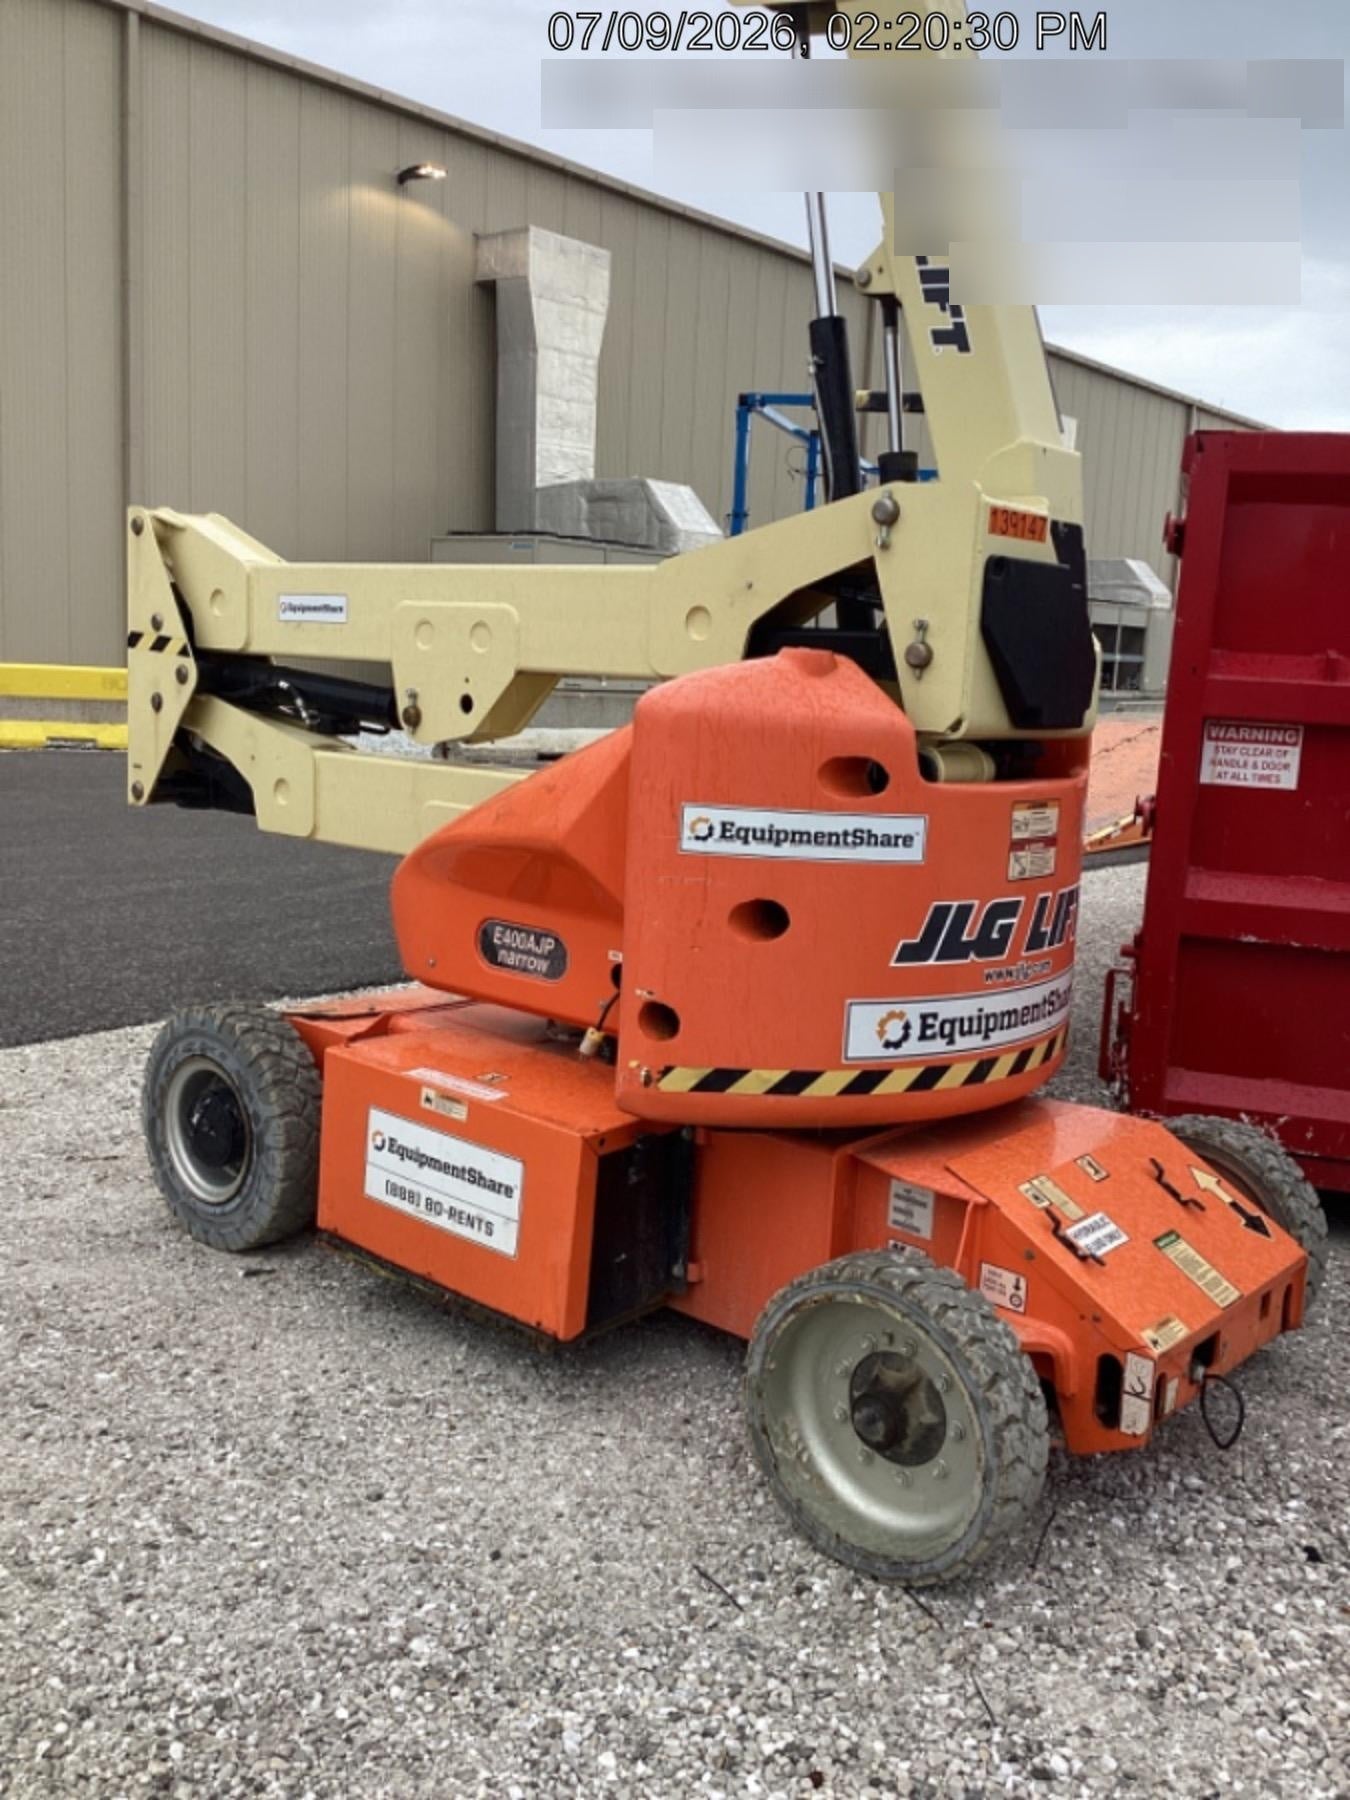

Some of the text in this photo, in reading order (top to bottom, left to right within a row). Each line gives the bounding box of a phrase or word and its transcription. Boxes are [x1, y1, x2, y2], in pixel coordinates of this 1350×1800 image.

[914, 255, 973, 354] IFT
[989, 507, 1048, 542] 139147
[1208, 725, 1298, 744] WARNING
[1210, 757, 1249, 769] HANDLE
[1262, 761, 1291, 771] DOOR
[1215, 745, 1239, 755] STAY
[1240, 746, 1273, 757] CLEAR
[1216, 770, 1281, 784] AT ALL TIMES
[719, 820, 916, 849] EquipmentShare
[493, 925, 556, 956] E400AJP
[889, 896, 1025, 967] JLG
[497, 949, 552, 974] narrow
[387, 1136, 515, 1199] EquipmentShare
[385, 1179, 421, 1207] (888)
